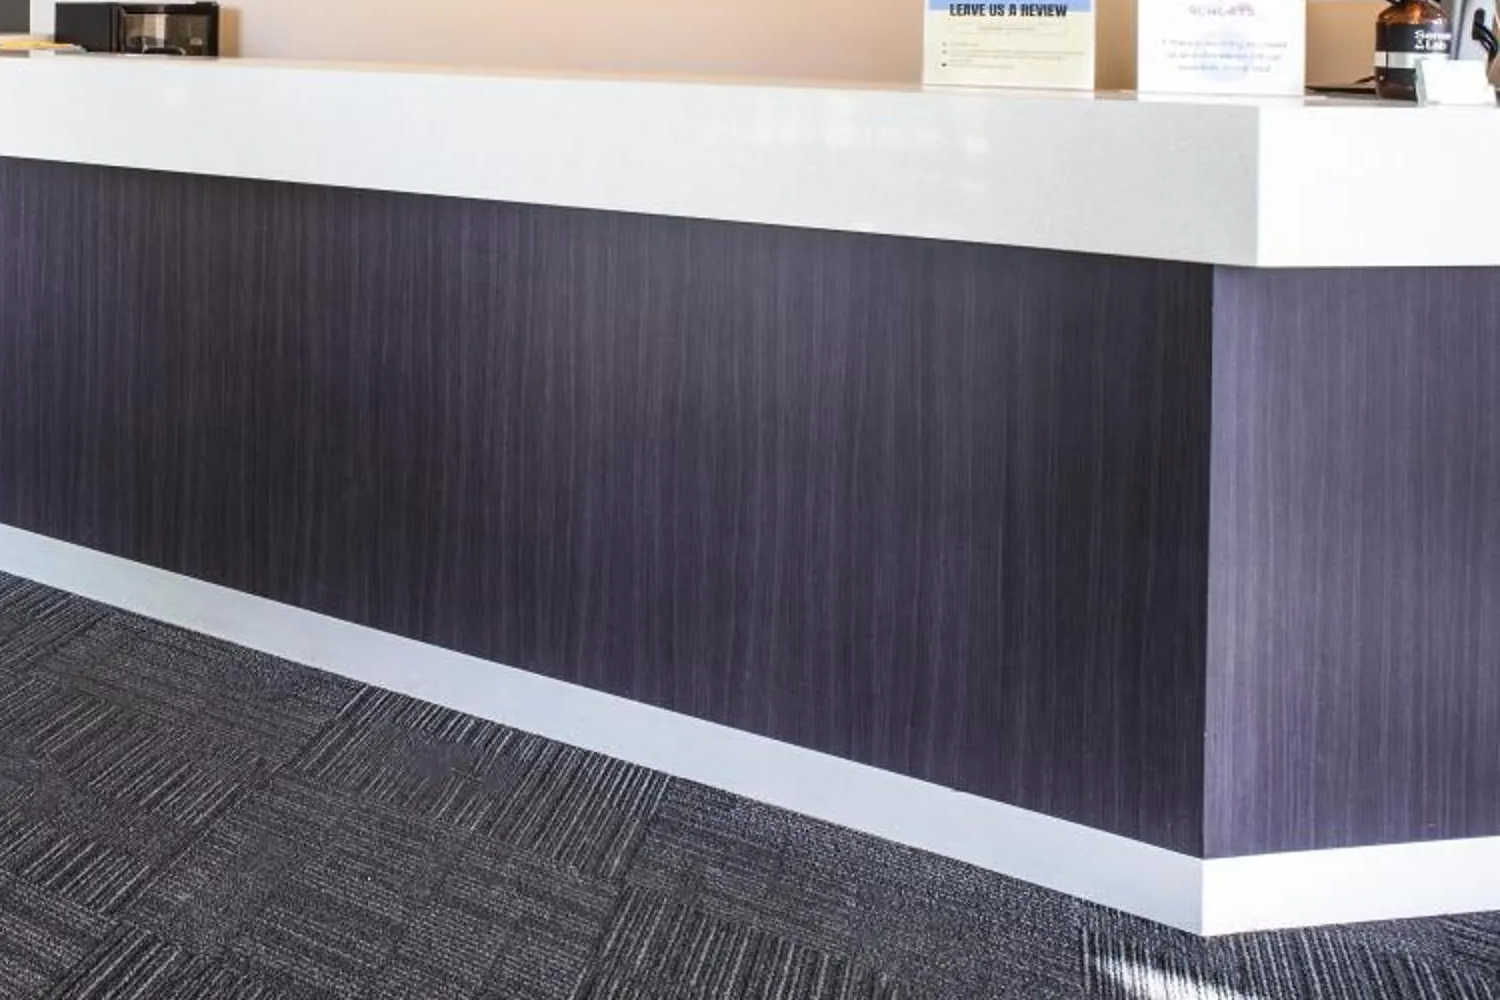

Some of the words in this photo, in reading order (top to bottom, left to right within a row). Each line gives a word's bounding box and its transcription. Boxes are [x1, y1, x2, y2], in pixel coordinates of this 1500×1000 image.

[949, 3, 986, 17] LEAVE
[989, 3, 1005, 17] US
[1009, 3, 1017, 17] A
[1020, 3, 1068, 17] REVIEW
